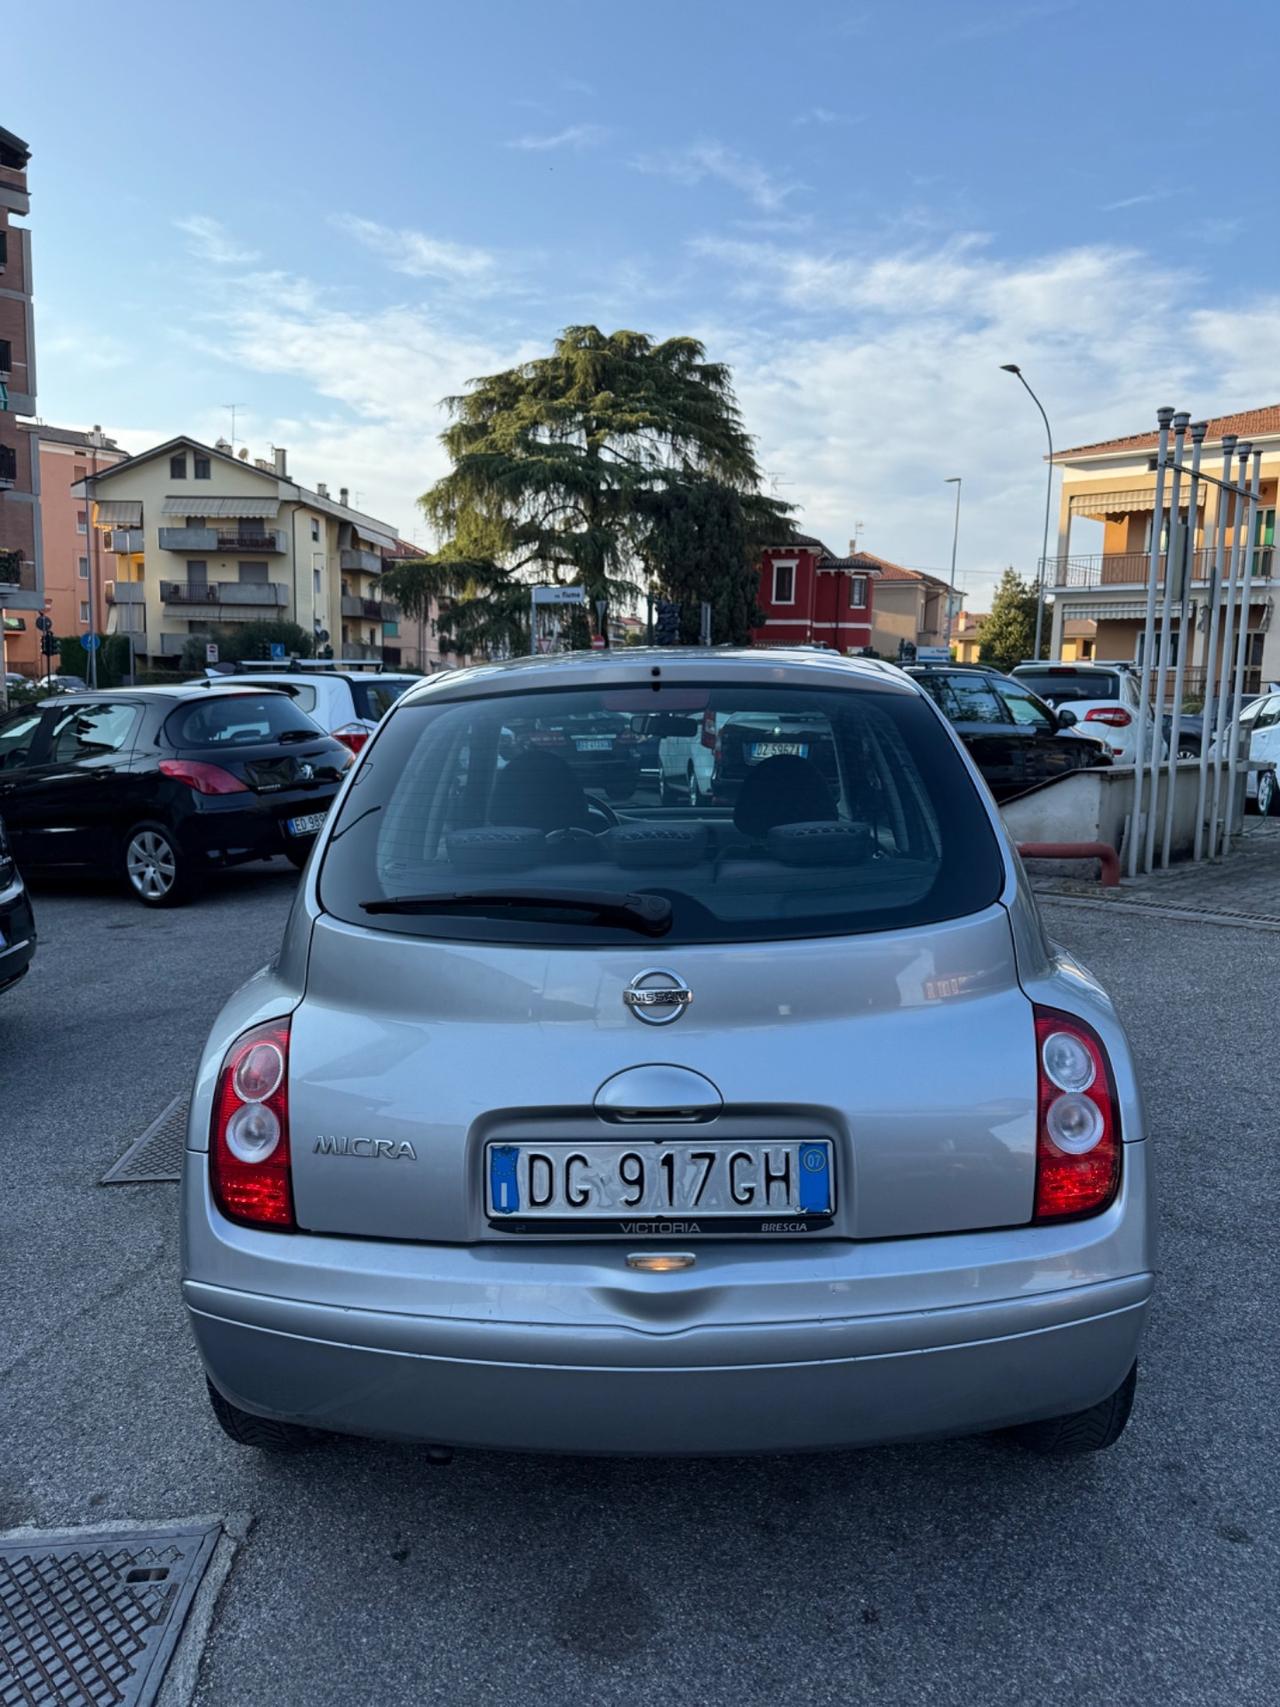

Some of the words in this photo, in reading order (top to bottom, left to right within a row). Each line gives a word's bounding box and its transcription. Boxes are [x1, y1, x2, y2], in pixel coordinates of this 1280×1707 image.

[631, 991, 687, 1002] NISSAN
[313, 1135, 417, 1160] MICRA
[807, 1154, 821, 1168] 07
[527, 1151, 590, 1208] DG
[618, 1149, 792, 1207] 917GH
[619, 1222, 702, 1234] VICTORIA
[761, 1222, 808, 1232] BRESCIA
